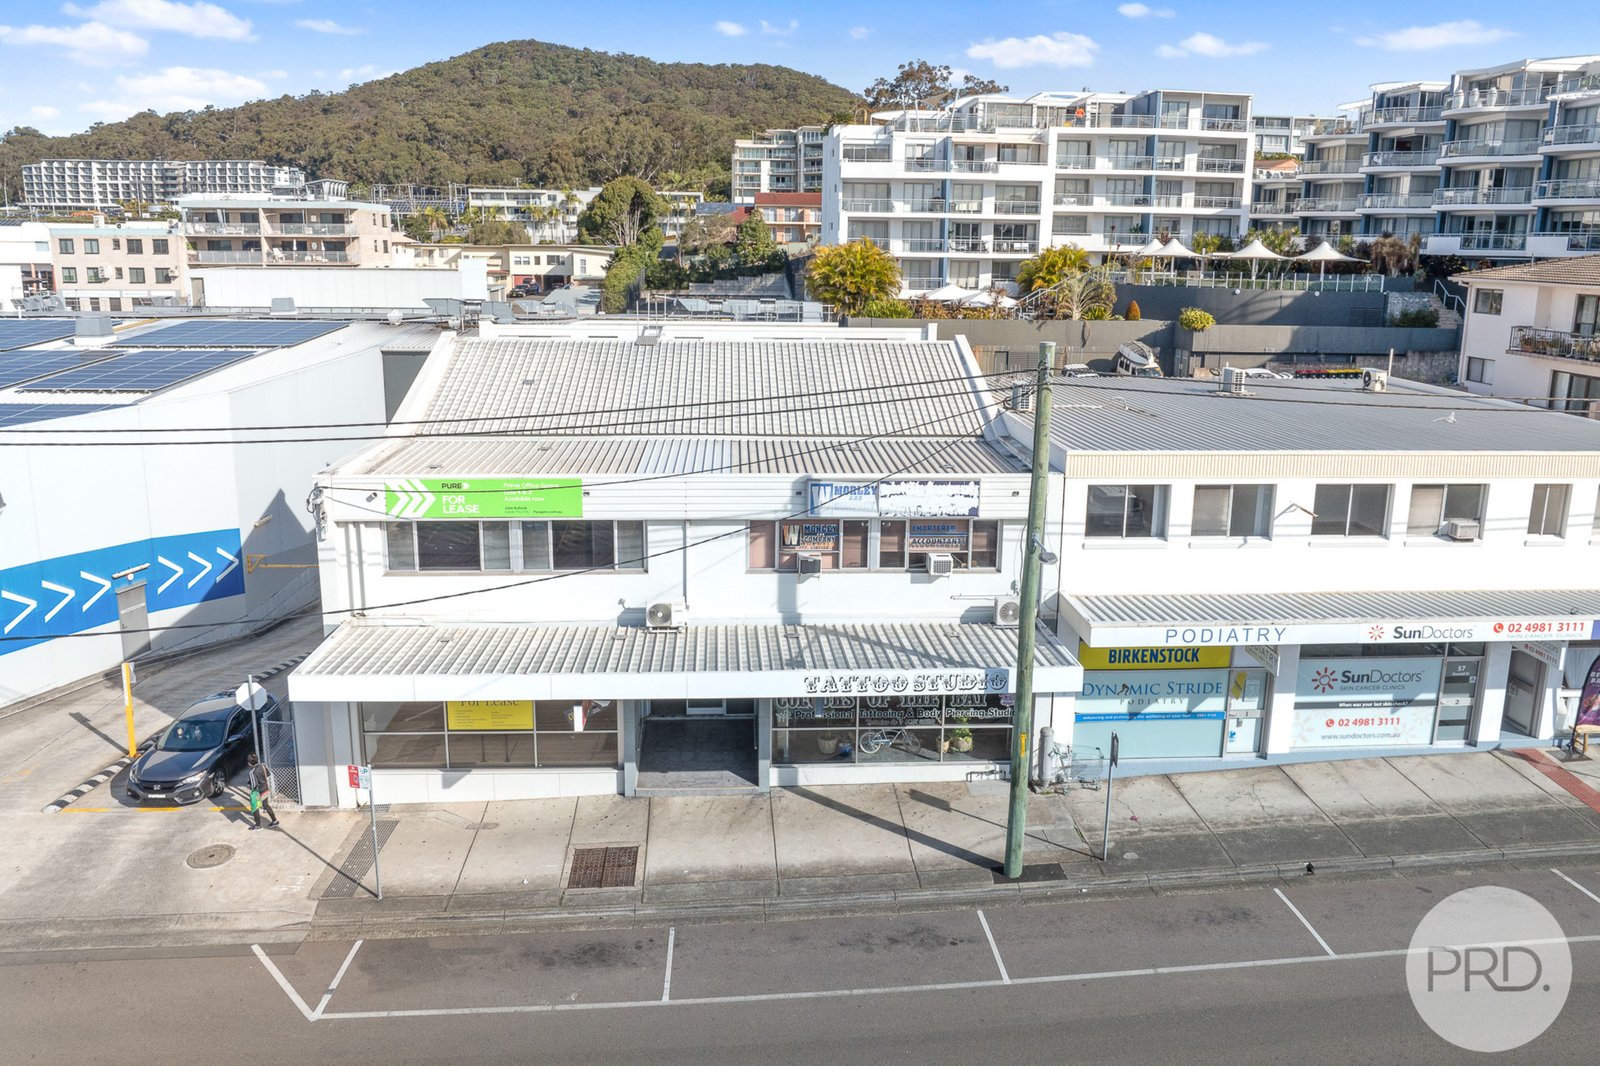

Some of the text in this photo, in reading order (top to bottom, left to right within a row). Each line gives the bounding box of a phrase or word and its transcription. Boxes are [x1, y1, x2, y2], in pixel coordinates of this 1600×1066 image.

[834, 485, 877, 495] MORLEY
[442, 495, 465, 504] FOR
[443, 504, 480, 514] LEASE
[803, 524, 838, 533] MORLEY
[1393, 625, 1474, 640] SunDoctors
[1508, 622, 1585, 633] 02 4981 3111
[1165, 627, 1287, 644] PODIATRY
[1108, 648, 1200, 664] BIRKENSTOCK
[1341, 669, 1422, 684] SunDoctors
[804, 673, 1008, 694] TATTOO STUDIO
[1166, 681, 1223, 695] STRIDE
[859, 708, 903, 719] Tattooing
[906, 708, 914, 717] &
[917, 708, 941, 719] Body
[946, 708, 985, 719] Piercing
[1338, 717, 1401, 727] 02 4981 3111
